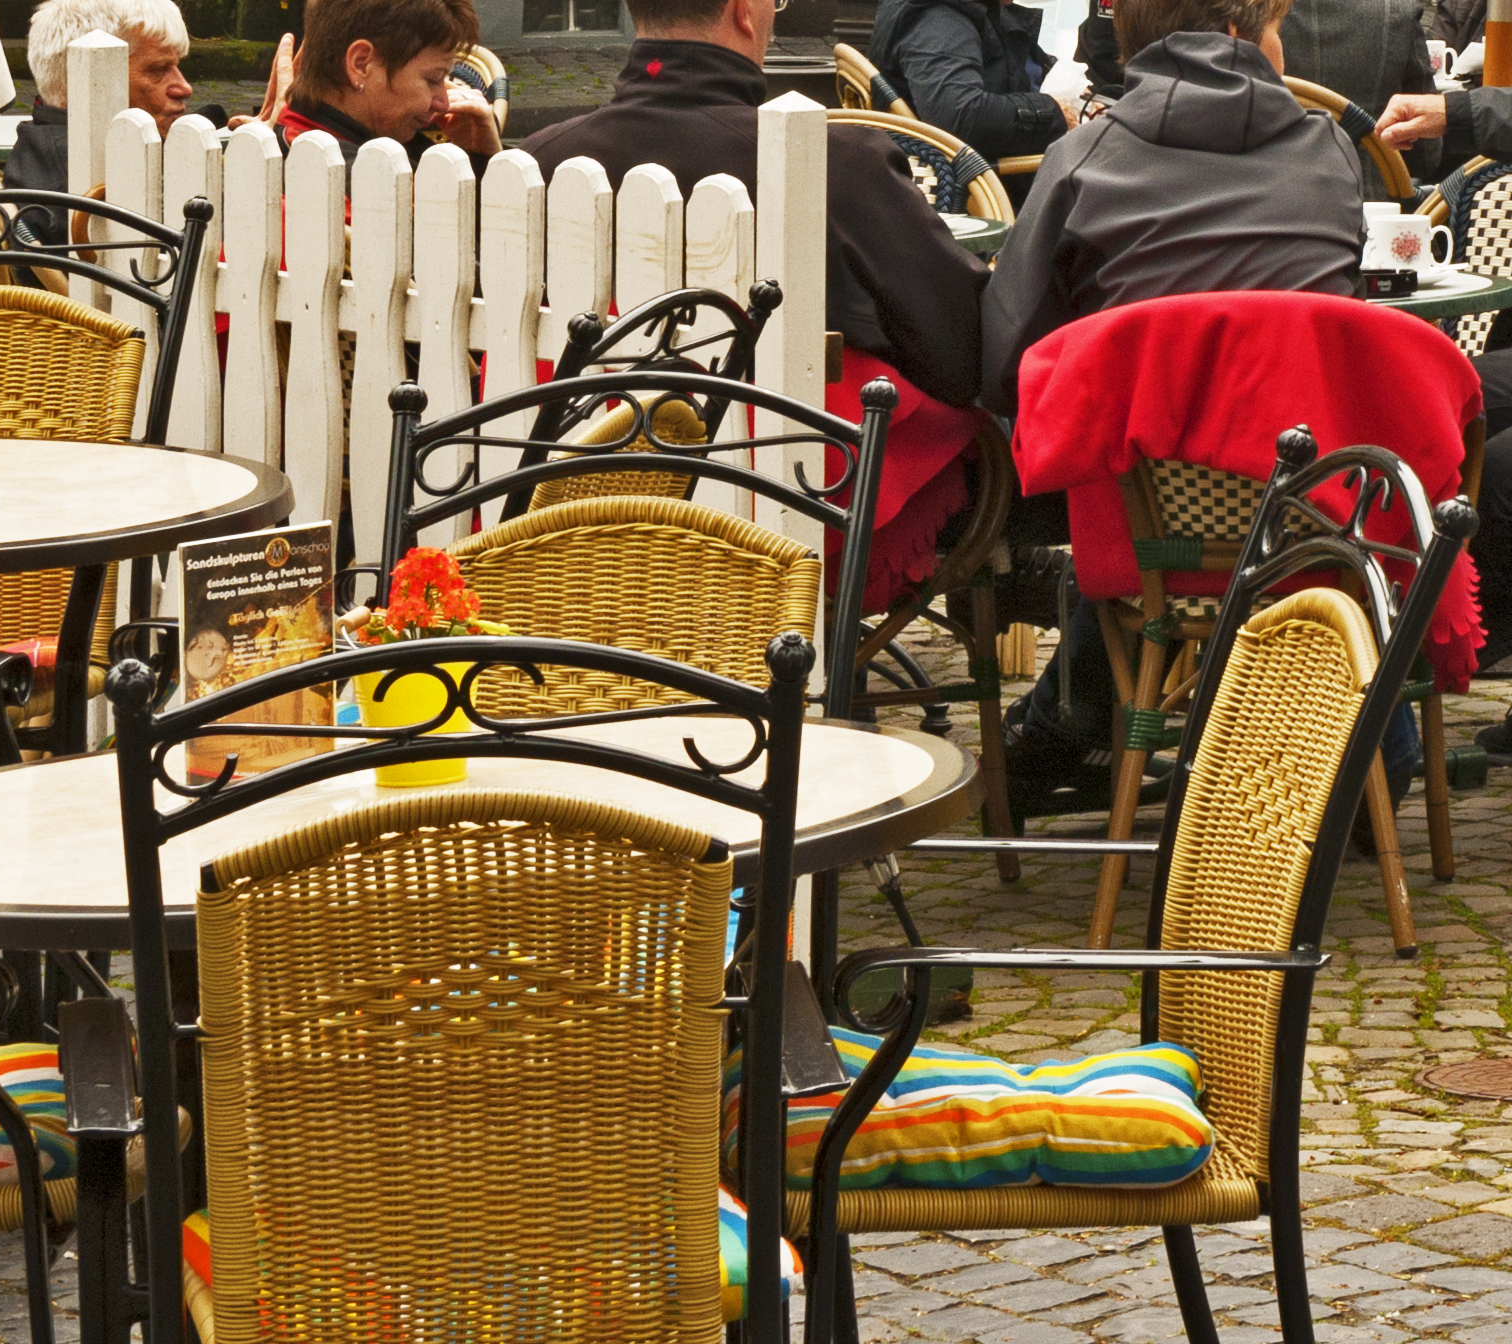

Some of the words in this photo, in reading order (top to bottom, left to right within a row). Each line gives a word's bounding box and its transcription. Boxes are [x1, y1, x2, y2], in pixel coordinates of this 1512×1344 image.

[186, 551, 265, 571] Sandskulpturen
[206, 575, 248, 589] Entdecken
[250, 573, 263, 583] Sie
[265, 570, 279, 581] die
[280, 567, 306, 578] Perlen
[307, 565, 323, 573] von
[238, 583, 276, 596] innerhalb
